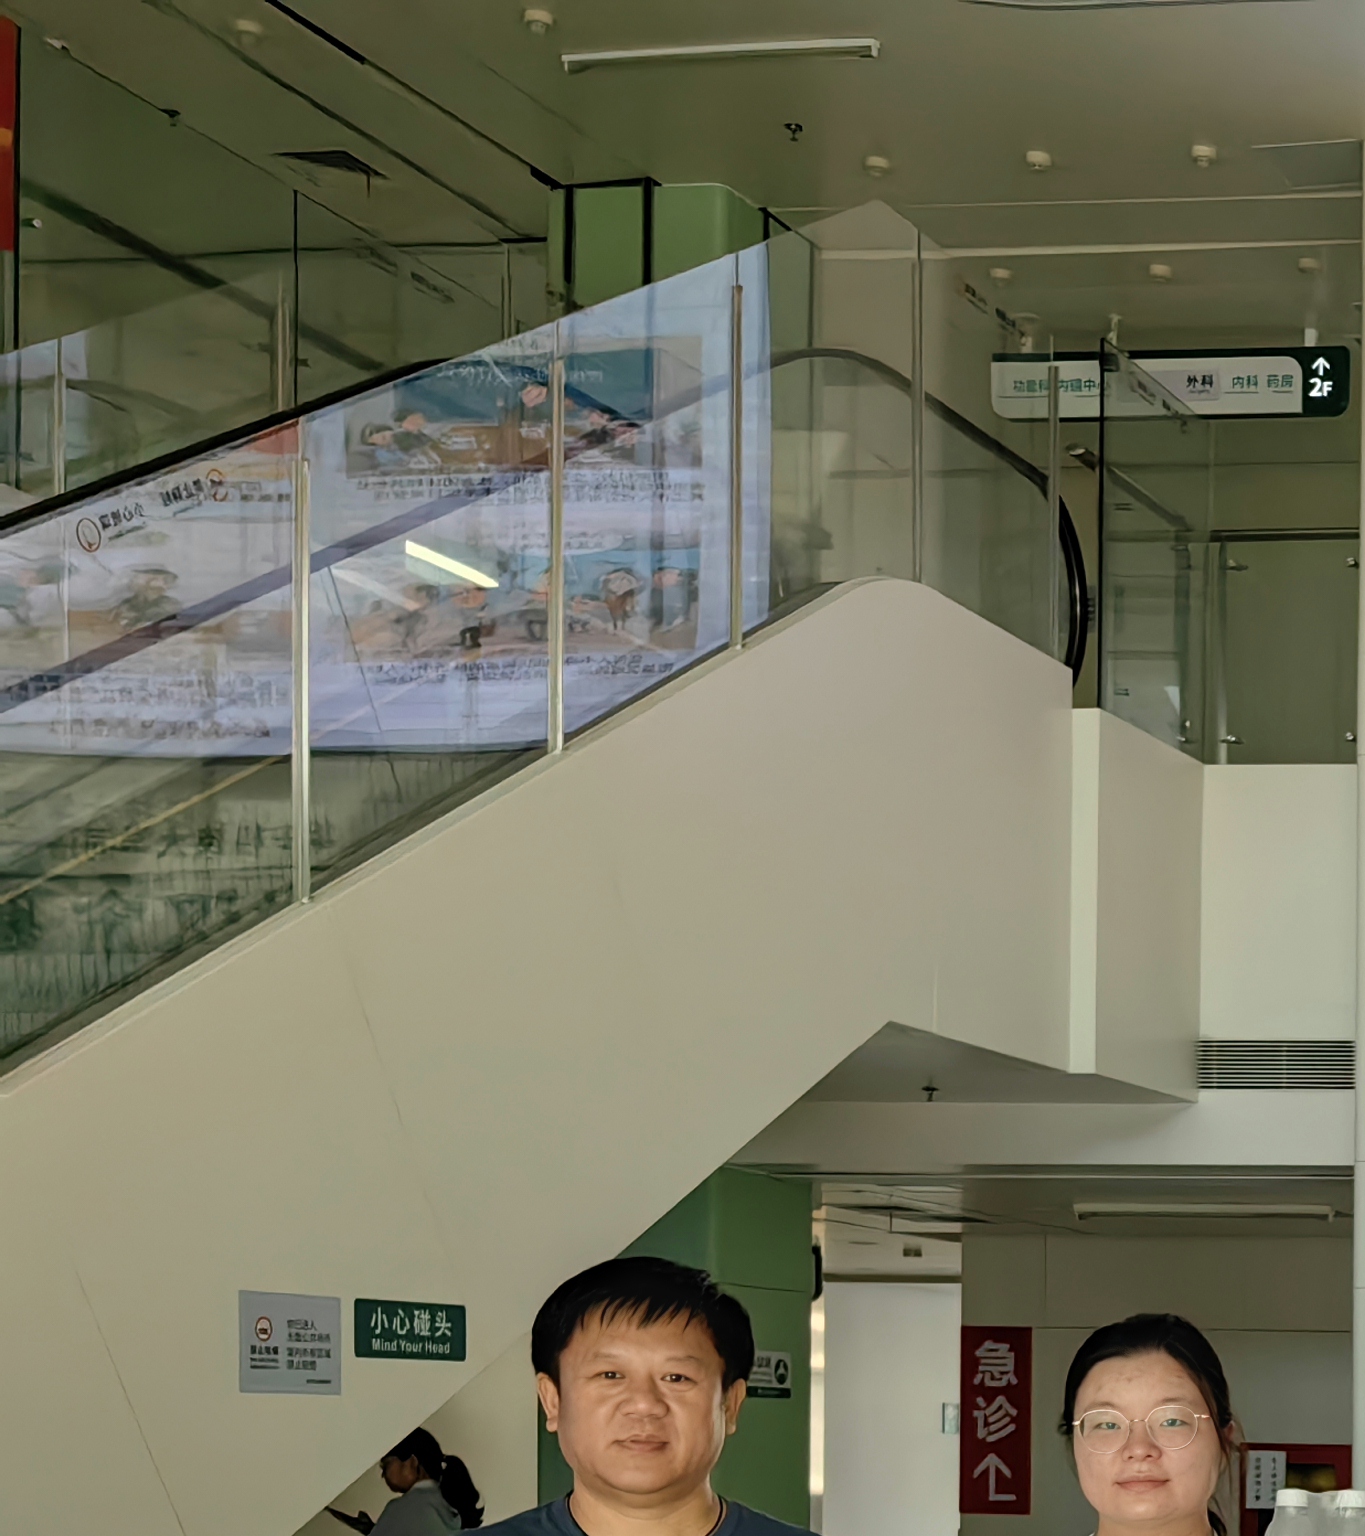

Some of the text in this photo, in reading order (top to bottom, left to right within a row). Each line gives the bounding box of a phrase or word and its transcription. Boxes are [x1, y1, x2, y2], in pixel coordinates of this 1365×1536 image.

[1186, 374, 1214, 388] 外科
[1231, 375, 1259, 390] 内科
[1308, 377, 1334, 397] 2F
[370, 1306, 452, 1338] 小心碰头
[372, 1338, 451, 1355] Mind Your Head
[973, 1340, 1018, 1443] 急诊
